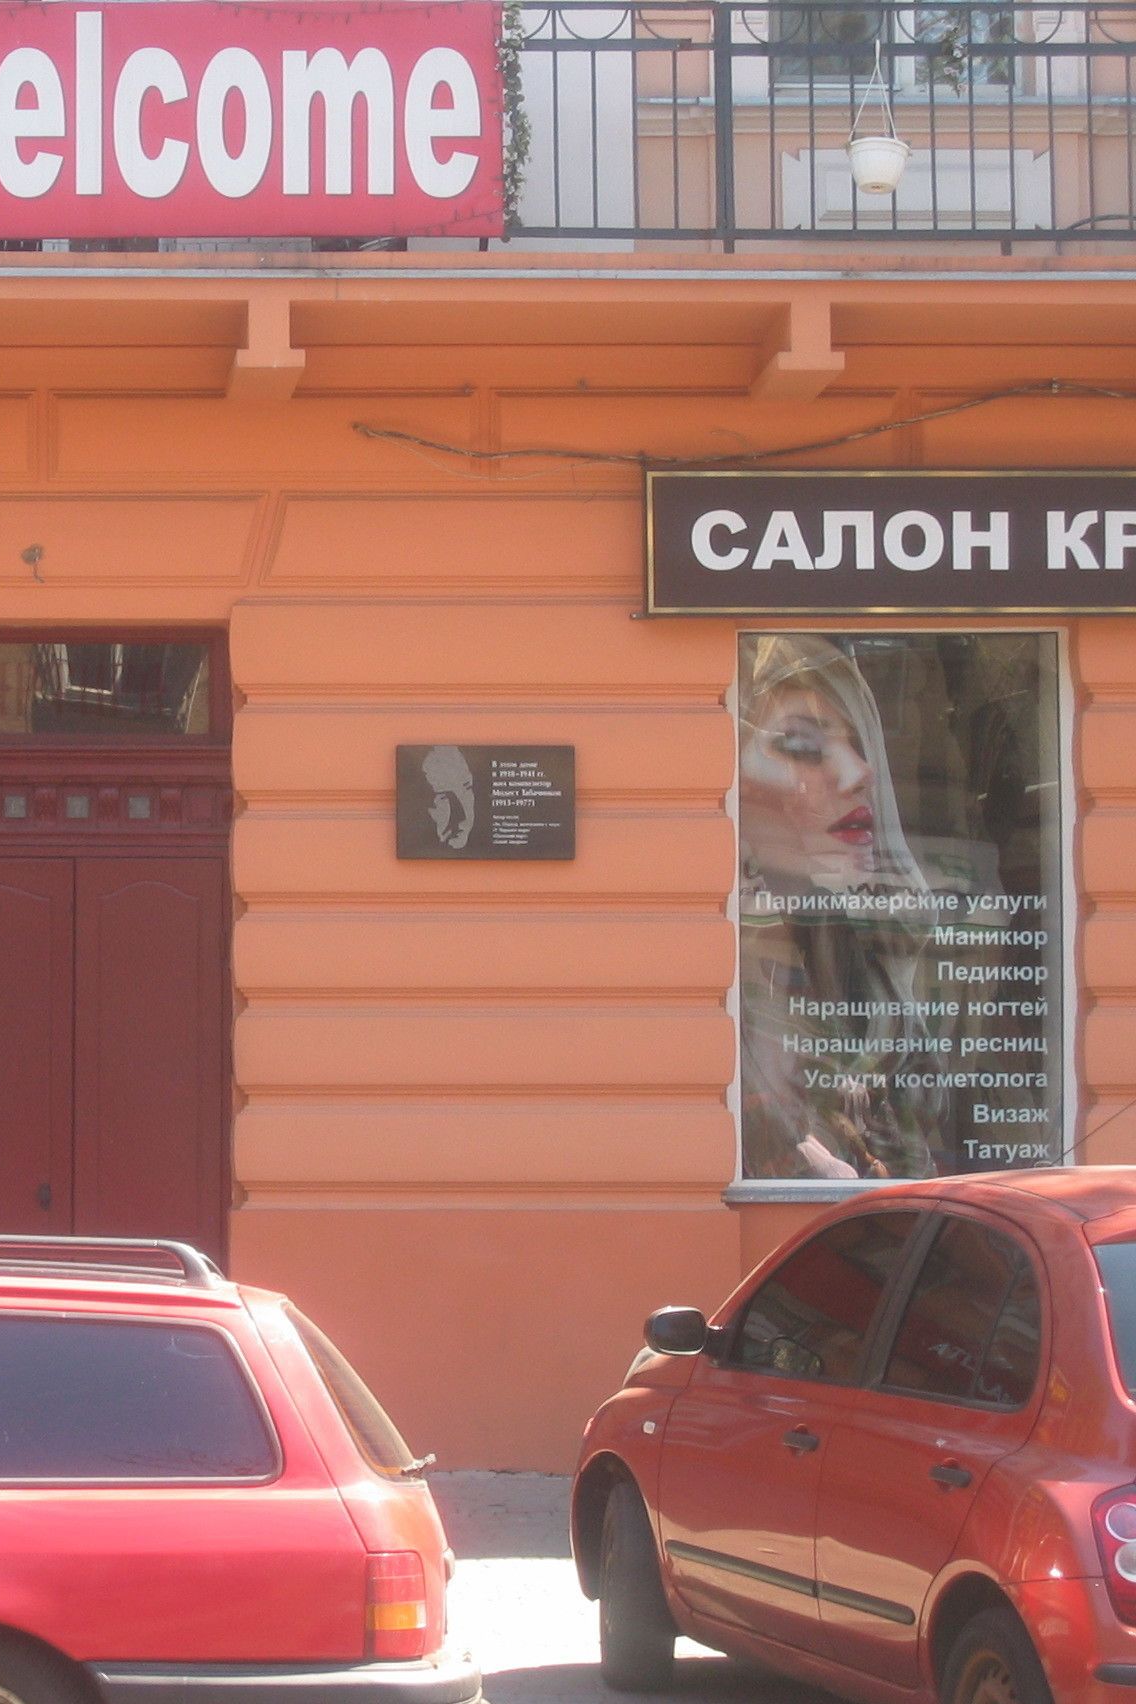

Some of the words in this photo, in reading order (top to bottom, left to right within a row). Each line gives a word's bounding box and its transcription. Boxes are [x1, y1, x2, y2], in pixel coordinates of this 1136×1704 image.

[690, 509, 1010, 571] САЛОН
[754, 890, 959, 913] Парикмахерские
[966, 894, 1048, 913] услуги
[934, 926, 1048, 948] Маникюр
[937, 962, 1049, 984] Педикюр
[788, 996, 960, 1018] Наращивание
[967, 996, 1049, 1016] ногтей
[782, 1033, 953, 1055] Наращивание
[960, 1036, 1048, 1056] ресниц
[804, 1069, 887, 1092] Услуги
[895, 1072, 1048, 1088] косметолога
[972, 1104, 1049, 1124] Визаж
[963, 1139, 1050, 1161] Татуаж
